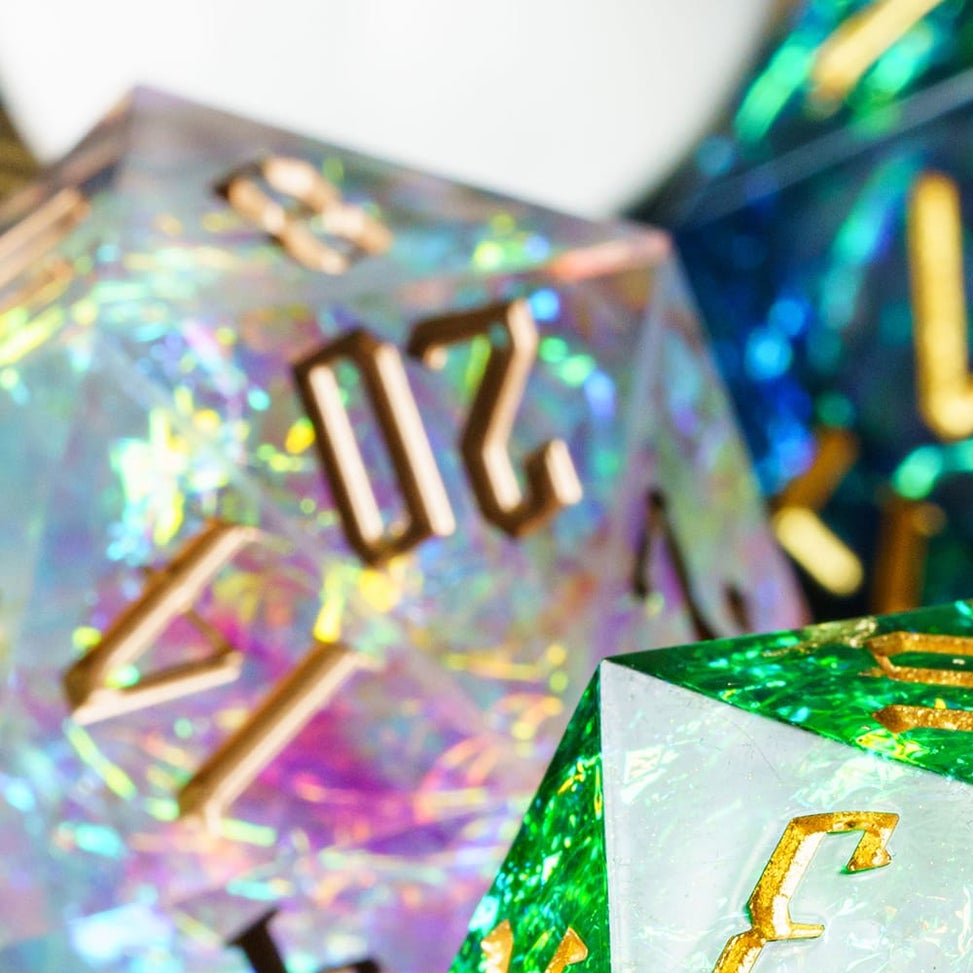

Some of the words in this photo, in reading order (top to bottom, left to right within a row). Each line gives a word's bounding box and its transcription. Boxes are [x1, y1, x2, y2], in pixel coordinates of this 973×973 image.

[215, 157, 395, 275] 8
[293, 299, 583, 567] 20
[64, 520, 385, 838] 14
